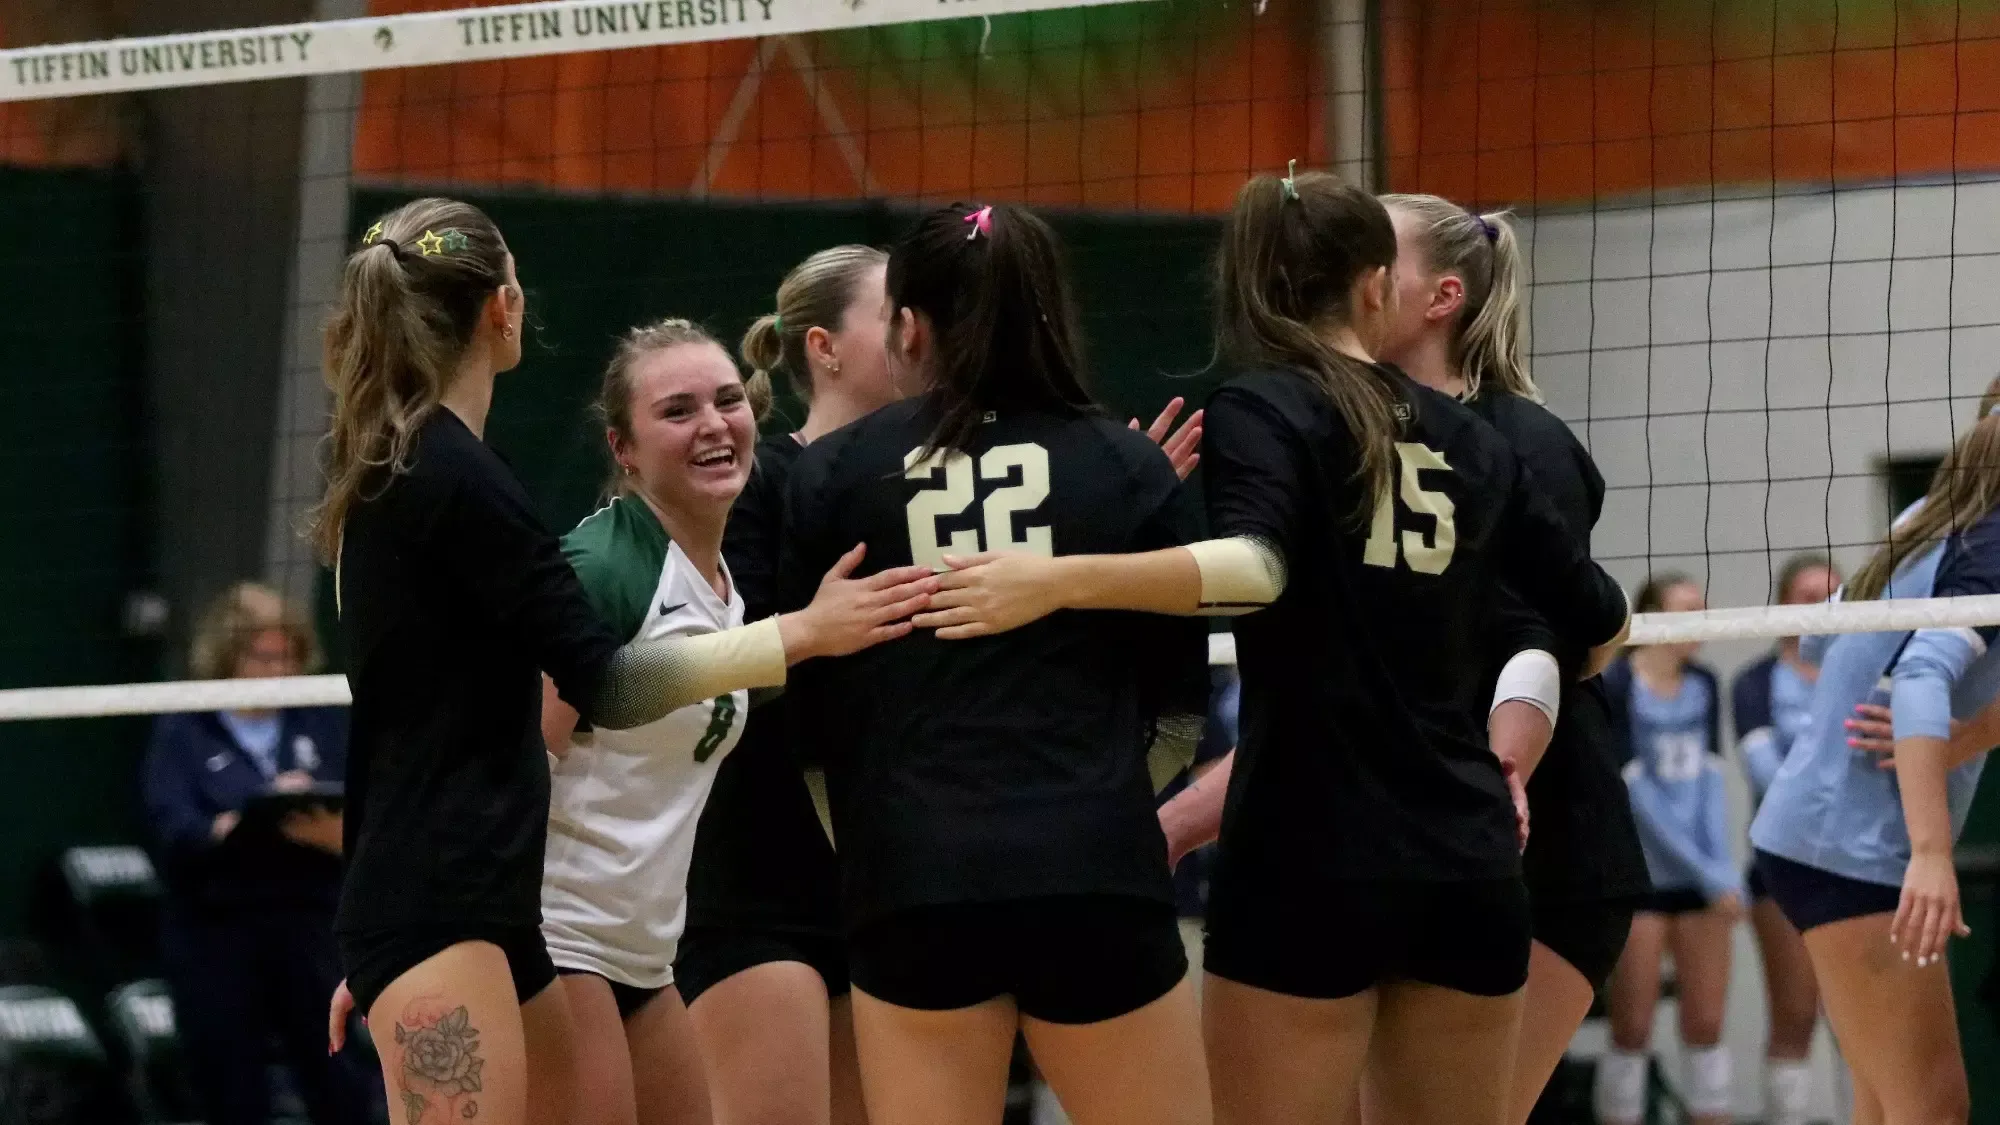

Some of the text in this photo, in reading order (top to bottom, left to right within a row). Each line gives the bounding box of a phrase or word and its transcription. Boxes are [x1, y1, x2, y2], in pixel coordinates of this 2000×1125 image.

[10, 30, 314, 86] TIFFIN UNIVERSITY
[457, 0, 775, 46] TIFFIN UNIVERSITY
[903, 442, 1054, 573] 22
[1363, 442, 1456, 576] 15
[694, 692, 736, 762] 8
